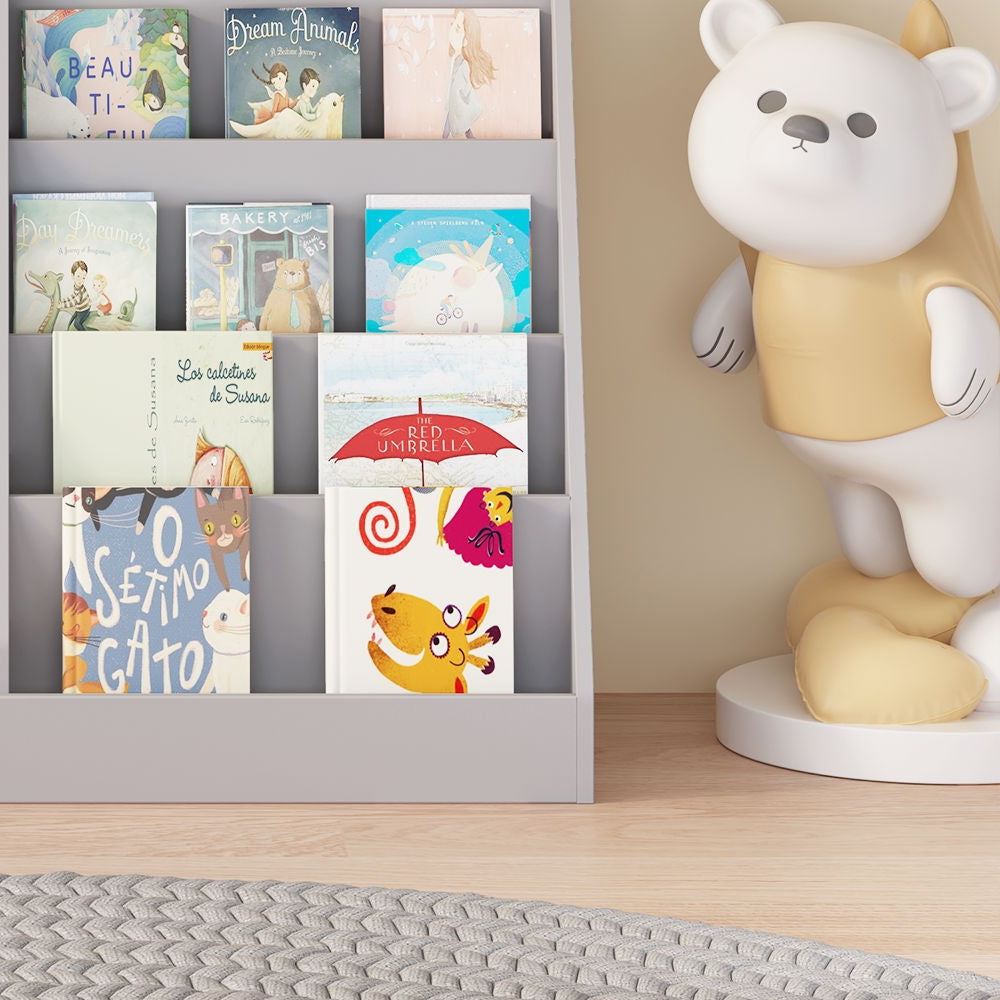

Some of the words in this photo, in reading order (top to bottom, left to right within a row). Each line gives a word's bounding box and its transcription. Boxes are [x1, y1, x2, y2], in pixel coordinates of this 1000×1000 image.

[226, 13, 287, 56] Dream
[290, 7, 360, 55] Animals
[69, 56, 147, 79] BEAU-
[89, 93, 126, 115] TI-
[220, 211, 289, 225] BAKERY
[16, 213, 57, 251] Day
[66, 208, 151, 255] Dreamers
[176, 358, 203, 383] Los
[206, 361, 257, 380] calcetines
[147, 356, 159, 431] Susana
[209, 385, 223, 403] de
[225, 383, 271, 404] Susana
[408, 426, 442, 439] RED
[416, 417, 433, 425] THE
[378, 439, 475, 454] UMBRELLA
[152, 505, 183, 567] O
[98, 619, 204, 693] GATO
